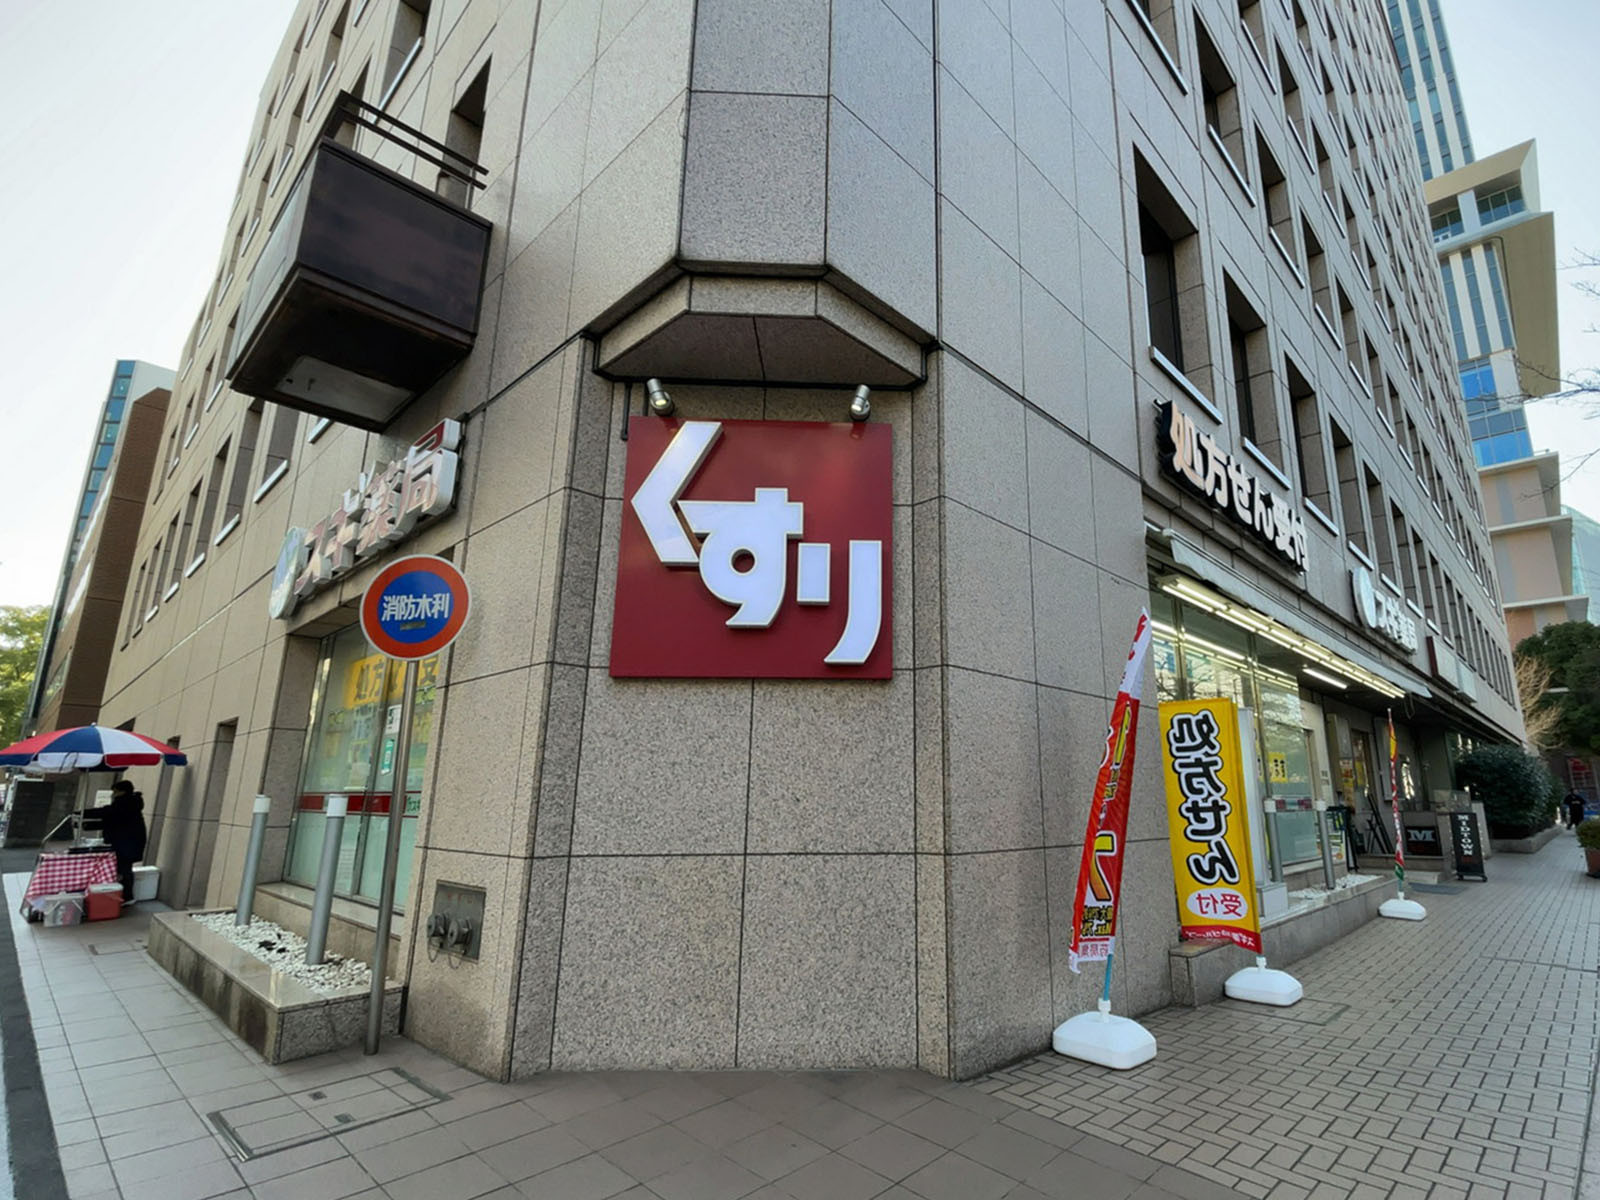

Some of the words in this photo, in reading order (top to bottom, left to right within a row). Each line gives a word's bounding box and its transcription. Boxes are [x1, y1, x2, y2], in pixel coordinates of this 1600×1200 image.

[294, 419, 460, 596] スギ薬局
[1170, 402, 1309, 573] 処方せん受付
[631, 421, 883, 664] くすり
[381, 592, 450, 621] 消防水利
[1407, 829, 1436, 842] M
[1457, 814, 1474, 856] MIDTOWN
